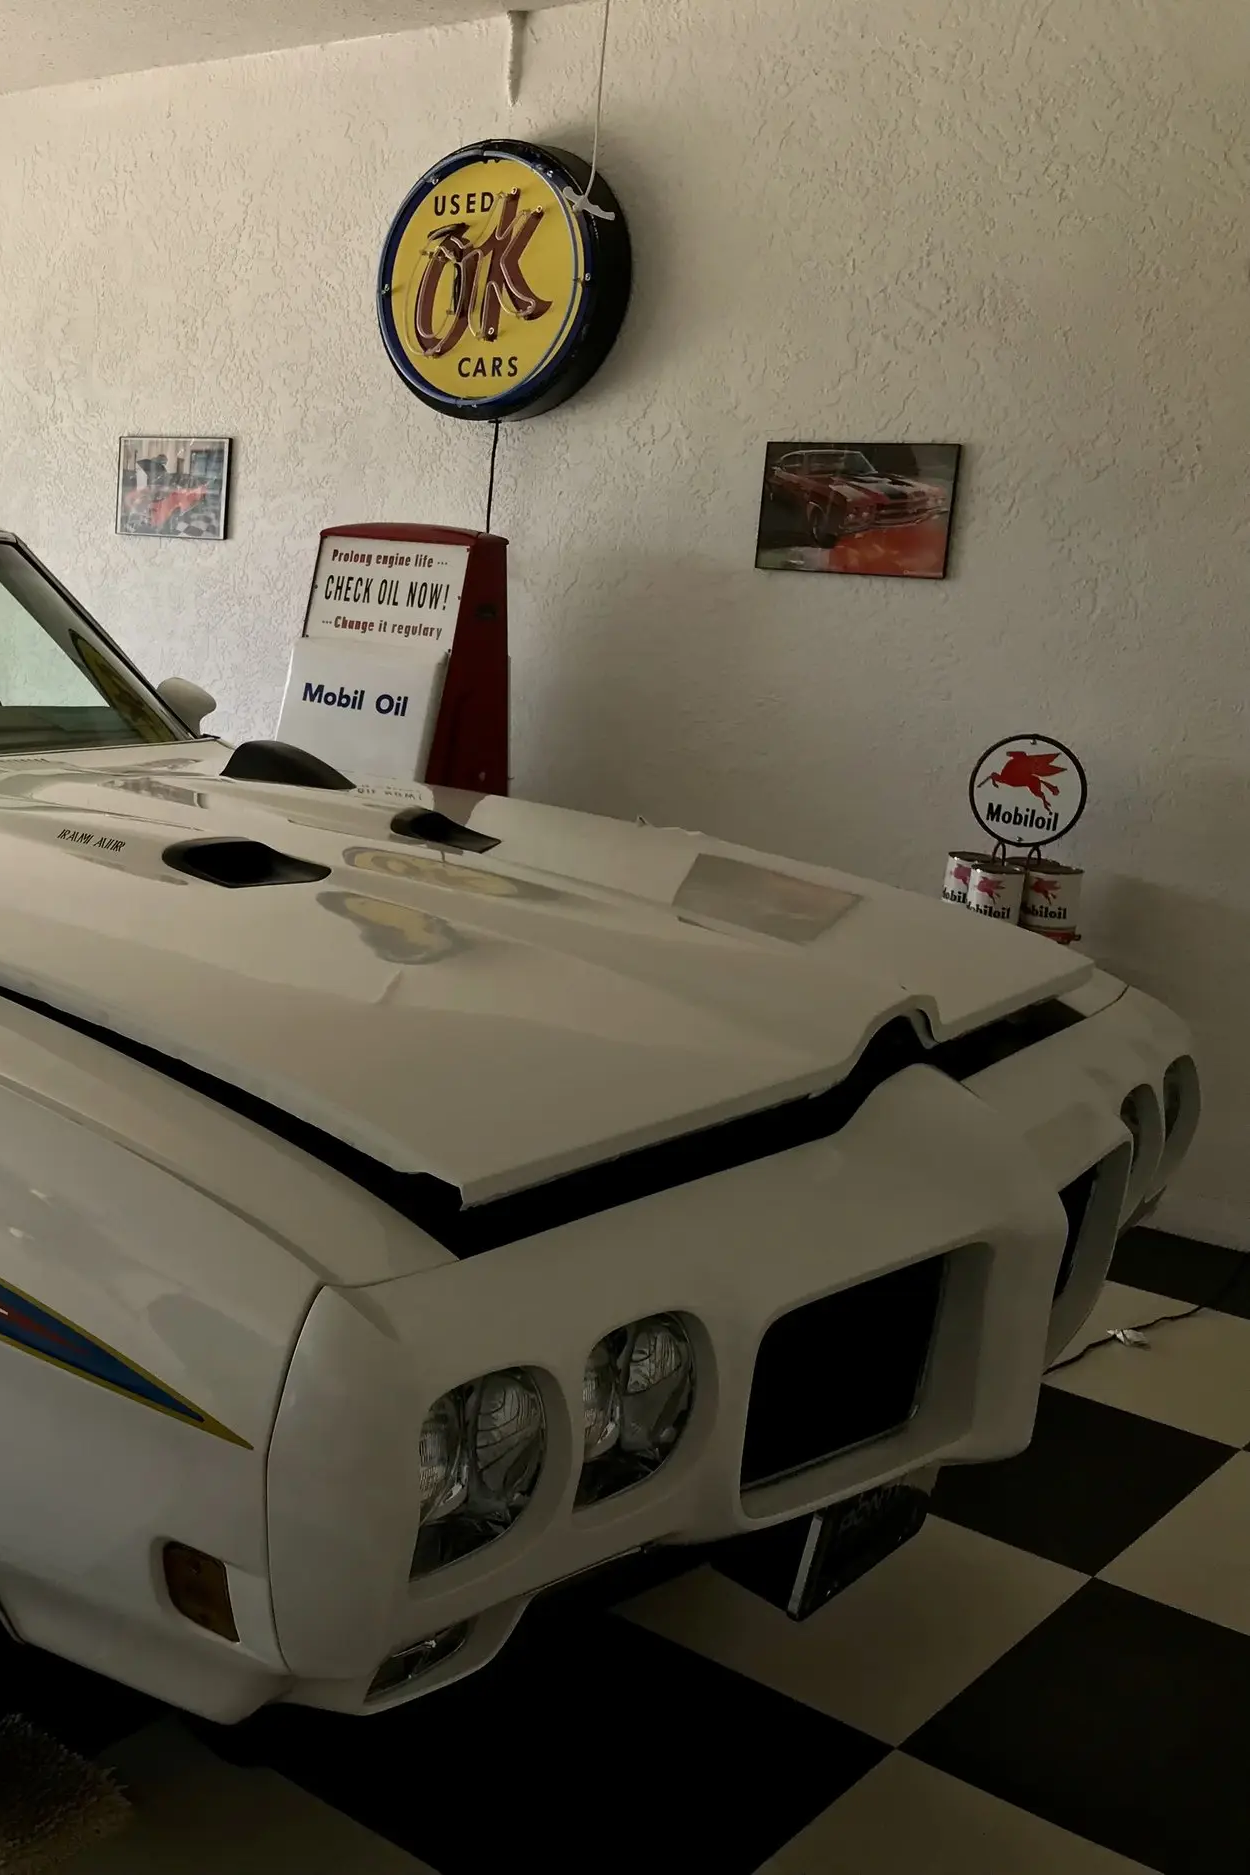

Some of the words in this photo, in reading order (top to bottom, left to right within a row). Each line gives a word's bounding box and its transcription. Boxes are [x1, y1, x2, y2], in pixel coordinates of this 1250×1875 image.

[434, 191, 496, 217] USED
[457, 356, 519, 378] CARS
[331, 549, 372, 567] Prolong
[375, 554, 411, 568] engine
[414, 554, 434, 568] life
[324, 574, 372, 604] CHECK
[377, 578, 400, 607] OIL
[406, 581, 450, 611] NOW!
[334, 615, 375, 634] Change
[378, 619, 389, 633] it
[391, 621, 443, 640] regulary
[302, 682, 366, 711] Mobil
[375, 694, 409, 717] Oil
[986, 802, 1059, 832] Mobiloil
